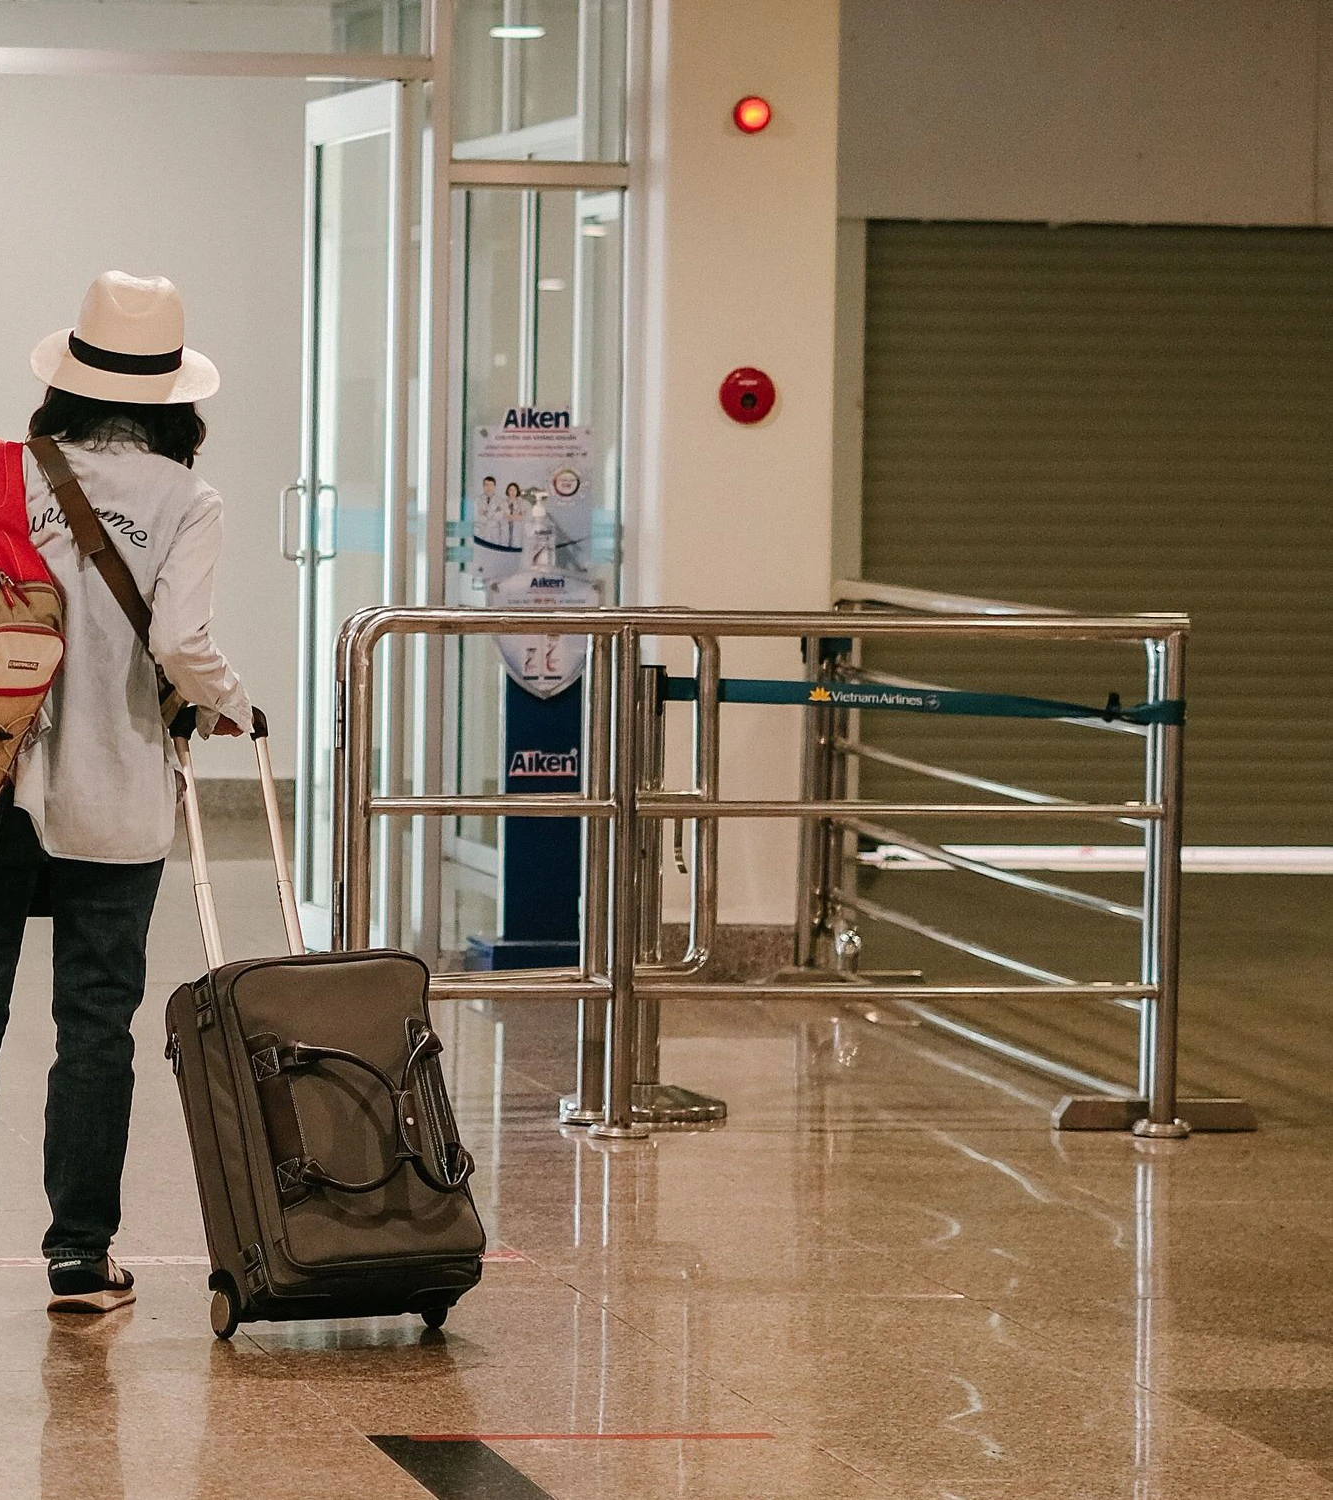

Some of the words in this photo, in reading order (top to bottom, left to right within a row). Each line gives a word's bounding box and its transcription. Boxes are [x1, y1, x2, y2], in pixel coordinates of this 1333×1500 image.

[503, 407, 571, 429] Aiken
[831, 691, 879, 704] Vietnam
[880, 692, 923, 706] Airlines
[511, 752, 577, 773] Aiken
